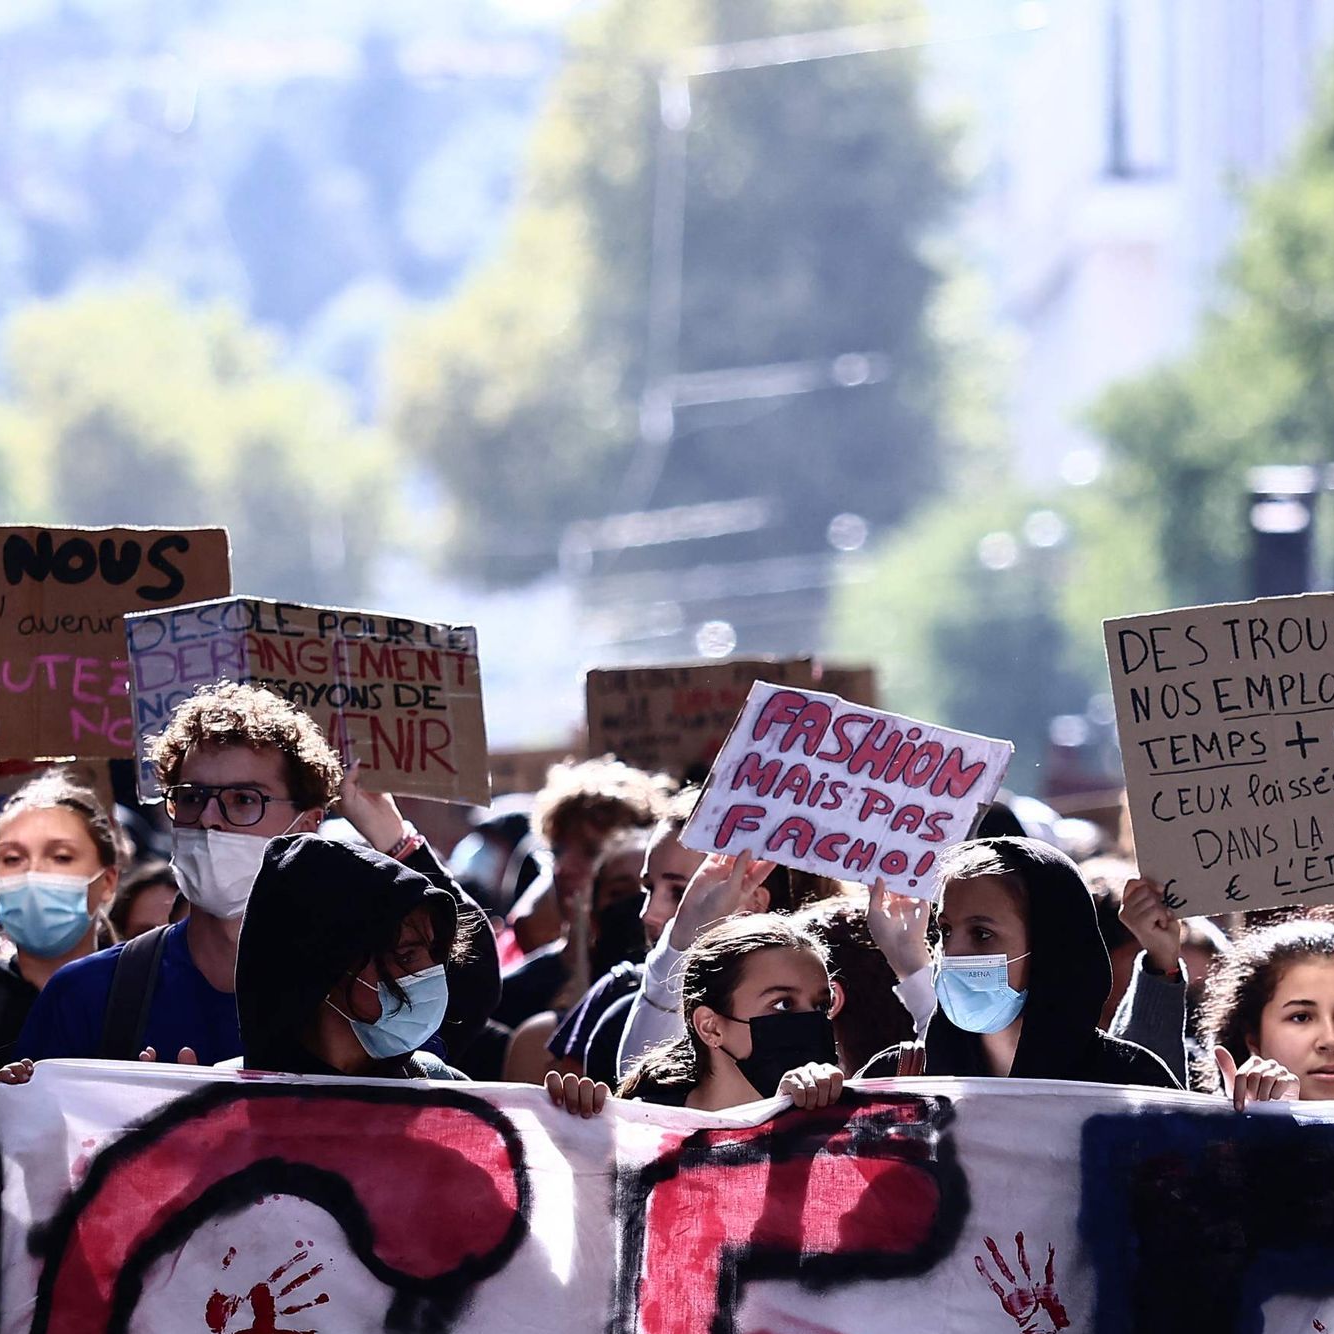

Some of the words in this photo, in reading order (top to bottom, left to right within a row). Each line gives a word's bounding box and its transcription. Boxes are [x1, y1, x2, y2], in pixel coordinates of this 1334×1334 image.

[2, 530, 190, 600] NOUS
[318, 609, 414, 646] POUR
[1118, 624, 1208, 675] DES
[133, 633, 479, 693] DERANGEMENT
[393, 683, 448, 711] DE
[1130, 680, 1202, 723] NOS
[328, 710, 458, 774] ENIR
[1139, 731, 1267, 770] TEMPS
[1285, 721, 1319, 759] +
[861, 786, 955, 842] PAS
[1152, 789, 1233, 823] CEUX
[713, 804, 937, 888] FACHO!
[1193, 827, 1278, 870] DANS
[1293, 816, 1324, 850] LA
